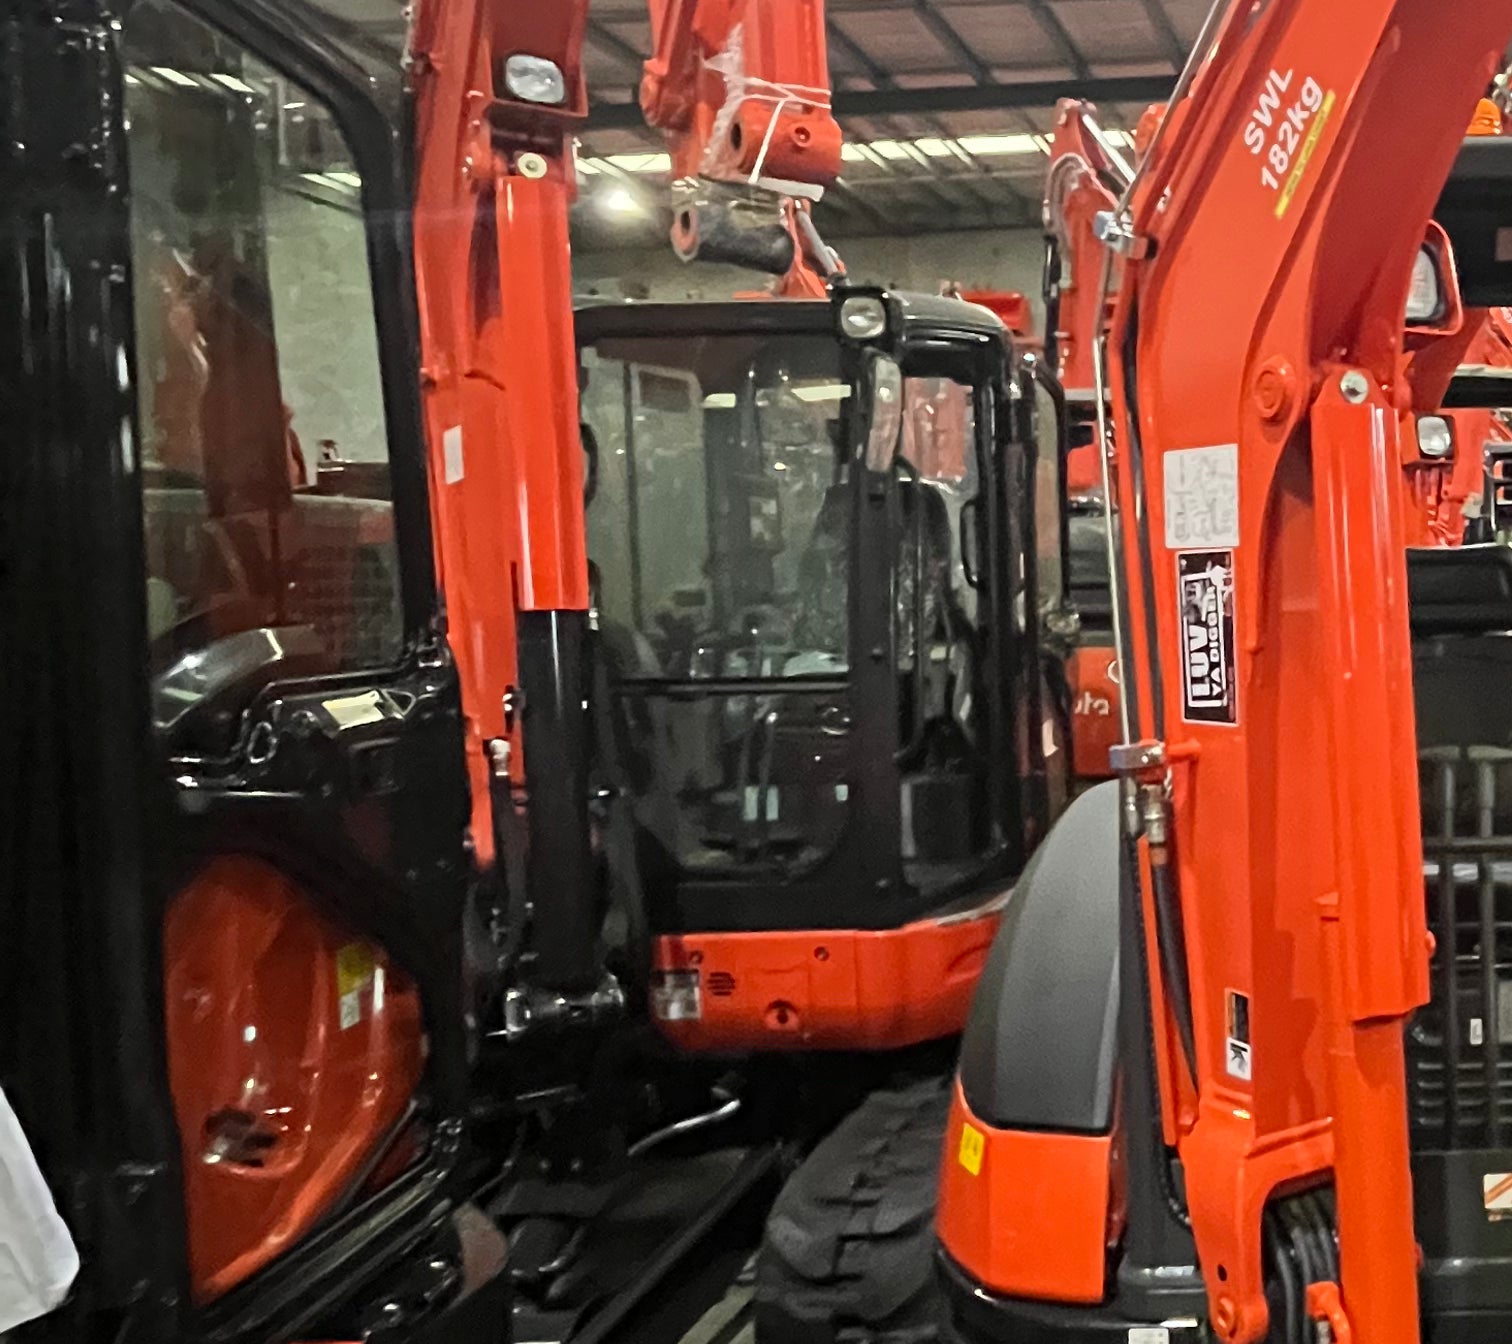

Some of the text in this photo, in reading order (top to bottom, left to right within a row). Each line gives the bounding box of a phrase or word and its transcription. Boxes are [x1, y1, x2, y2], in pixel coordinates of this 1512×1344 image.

[1244, 68, 1293, 155] SWL
[1261, 76, 1323, 190] 182kg
[1189, 623, 1210, 697] LUV
